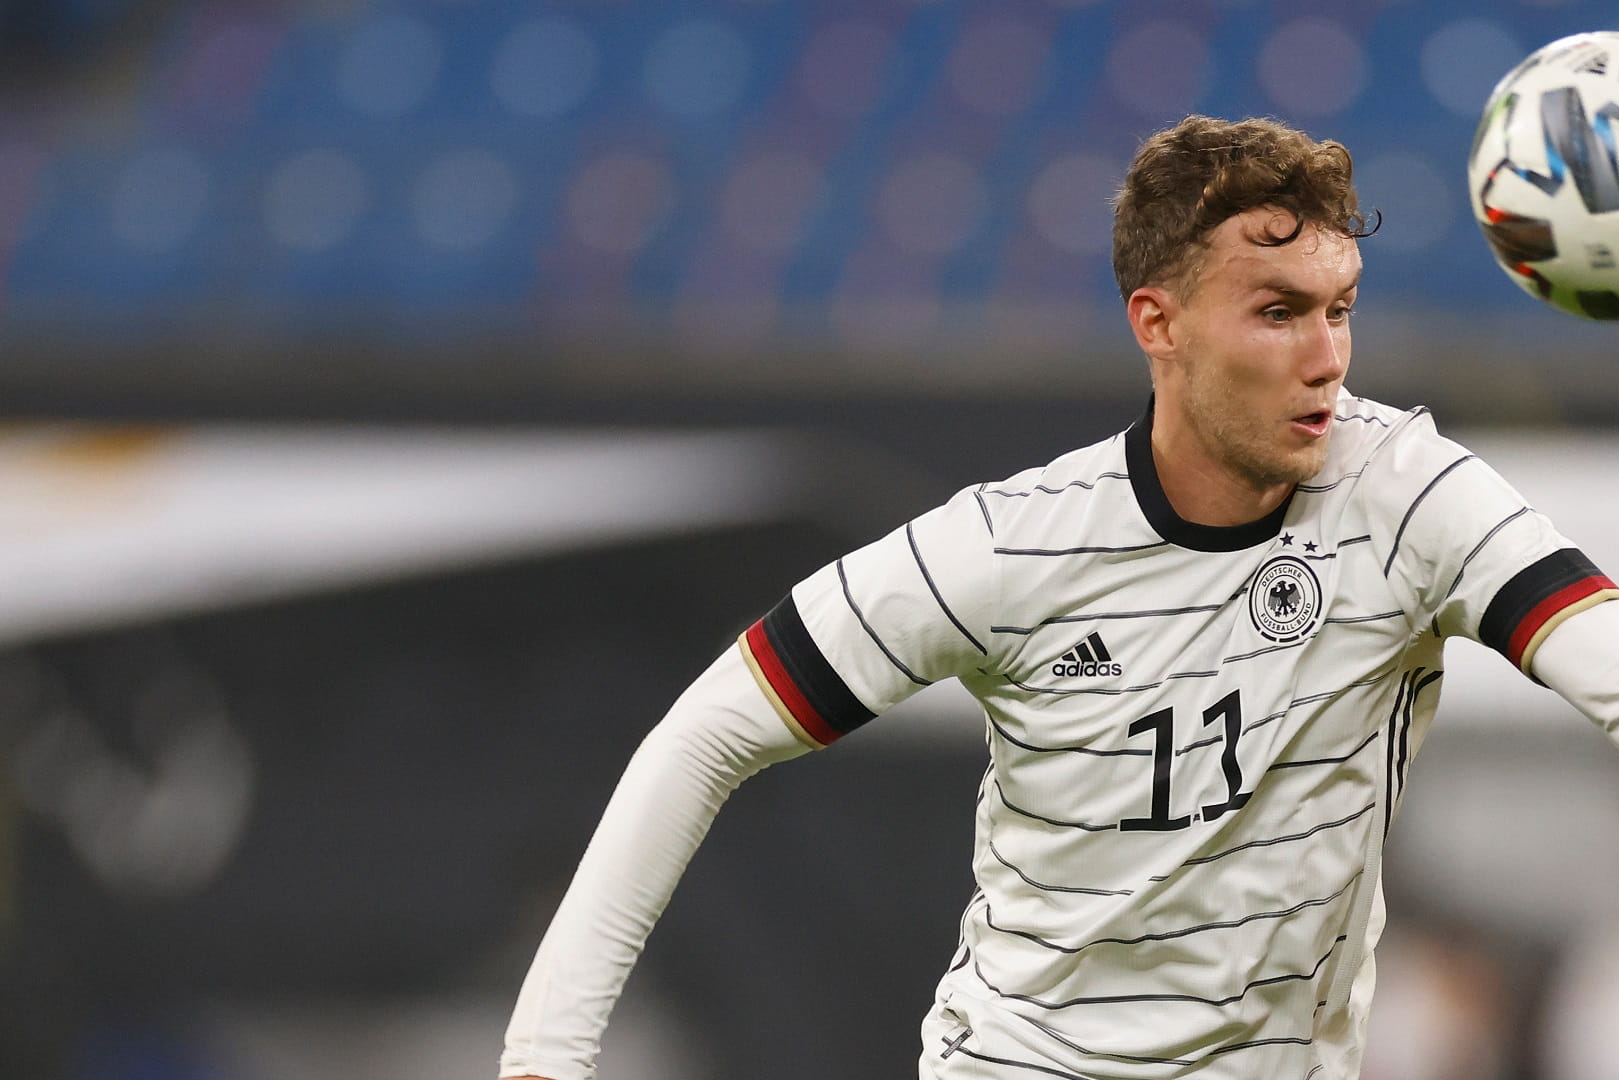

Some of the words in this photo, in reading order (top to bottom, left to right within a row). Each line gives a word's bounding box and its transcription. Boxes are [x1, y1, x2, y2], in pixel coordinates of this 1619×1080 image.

[1262, 566, 1302, 587] DEUTSCHER
[1261, 602, 1311, 631] FUSSBALL-BUND
[1052, 661, 1122, 677] adidas
[1119, 689, 1253, 832] 11
